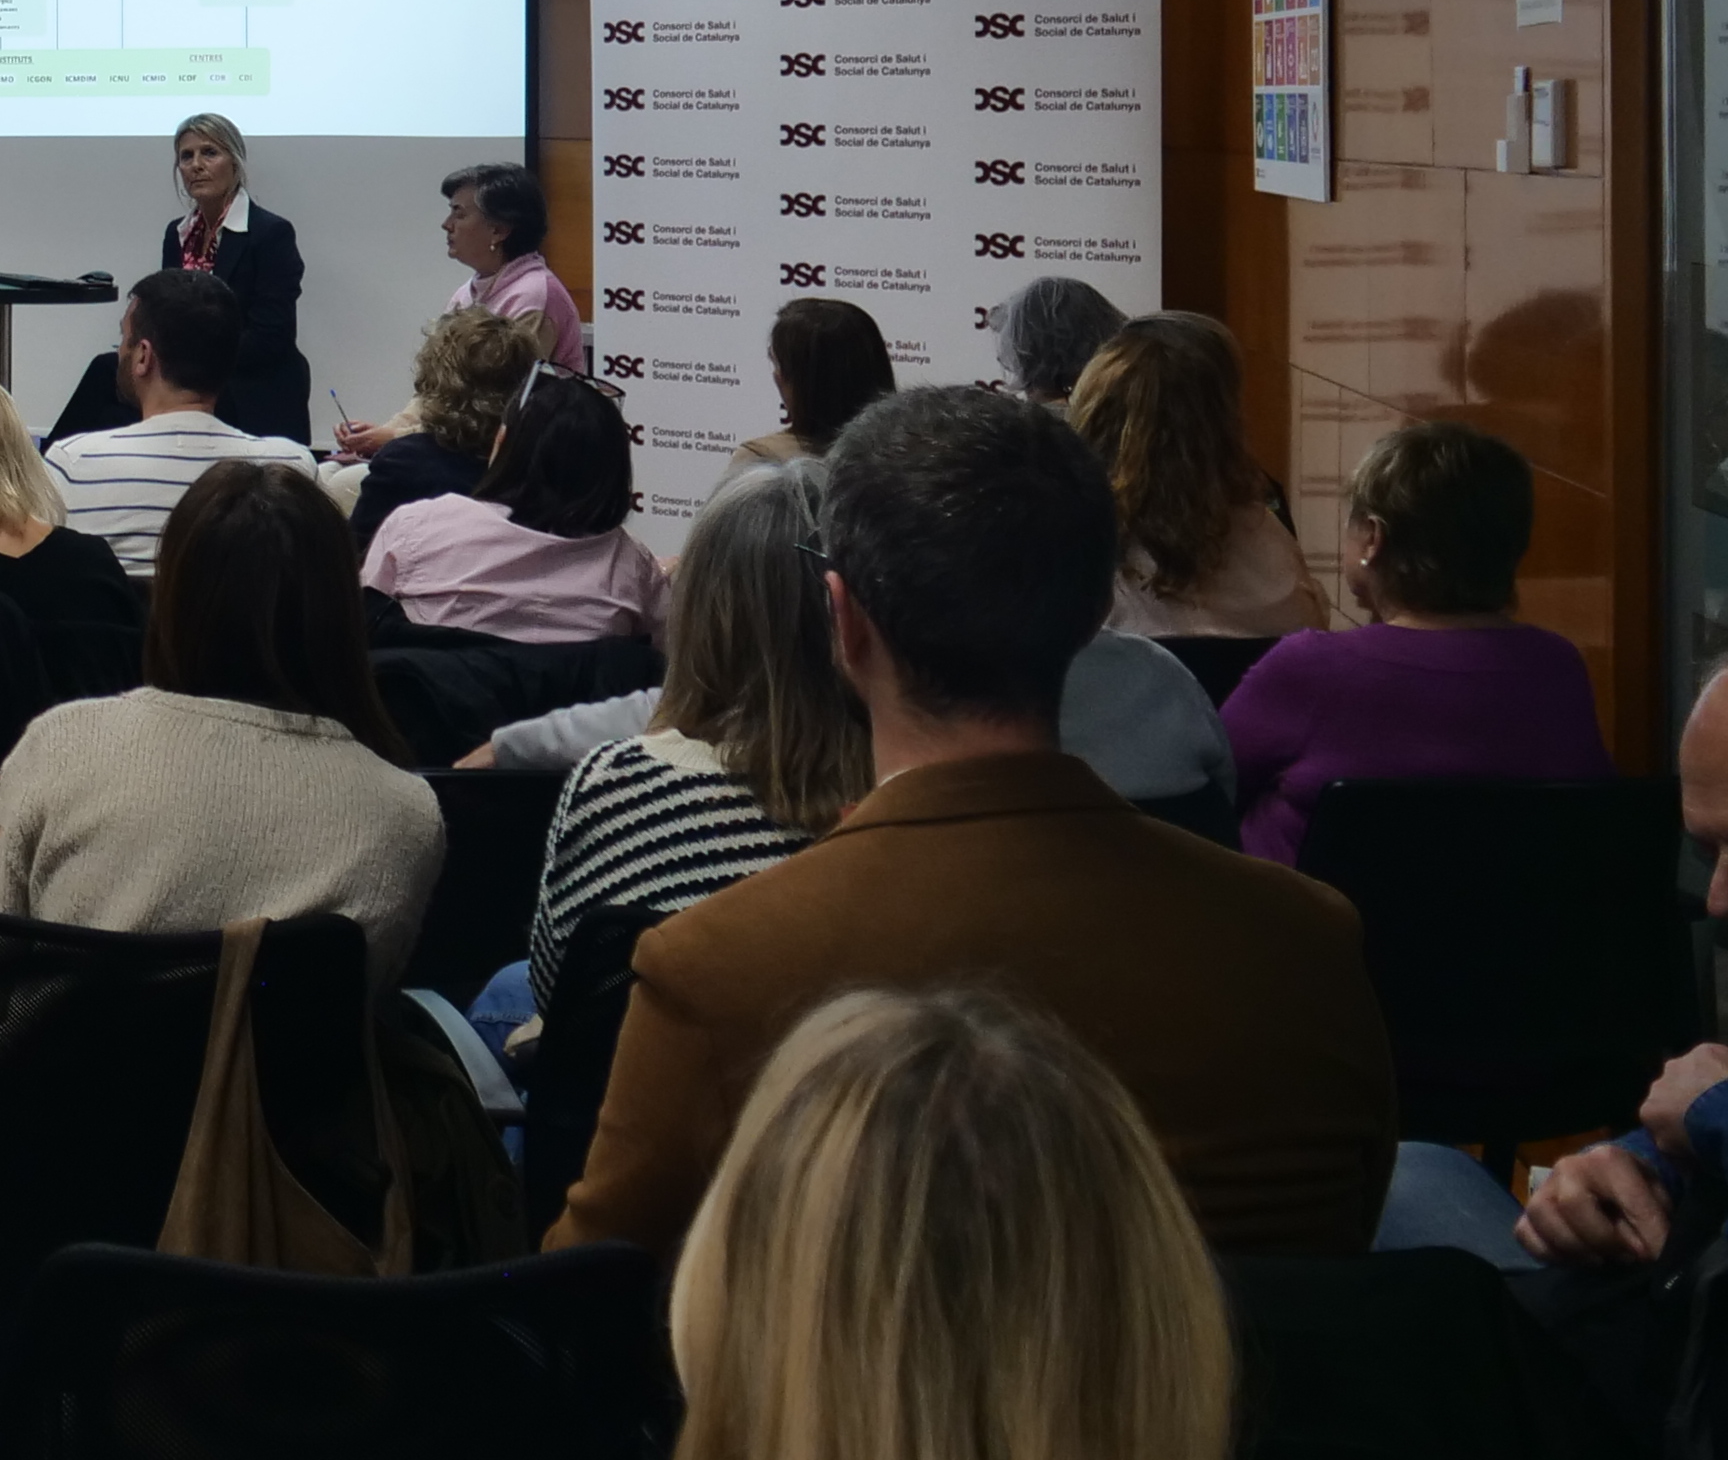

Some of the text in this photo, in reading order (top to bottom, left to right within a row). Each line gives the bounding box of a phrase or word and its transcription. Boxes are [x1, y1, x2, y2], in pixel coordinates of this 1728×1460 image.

[1035, 14, 1082, 24] Consorci
[1086, 14, 1098, 24] de
[1102, 14, 1129, 23] Salut
[1035, 27, 1141, 37] Social de Catalunya
[189, 54, 223, 63] CENTRES
[835, 55, 878, 64] Consorci
[881, 55, 893, 63] de
[896, 55, 921, 63] Salut
[835, 67, 931, 77] Social de Catalunya
[1035, 89, 1082, 98] Consorci
[1085, 89, 1098, 98] de
[1101, 89, 1129, 98] Salut
[1035, 102, 1141, 113] Social de Catalunya
